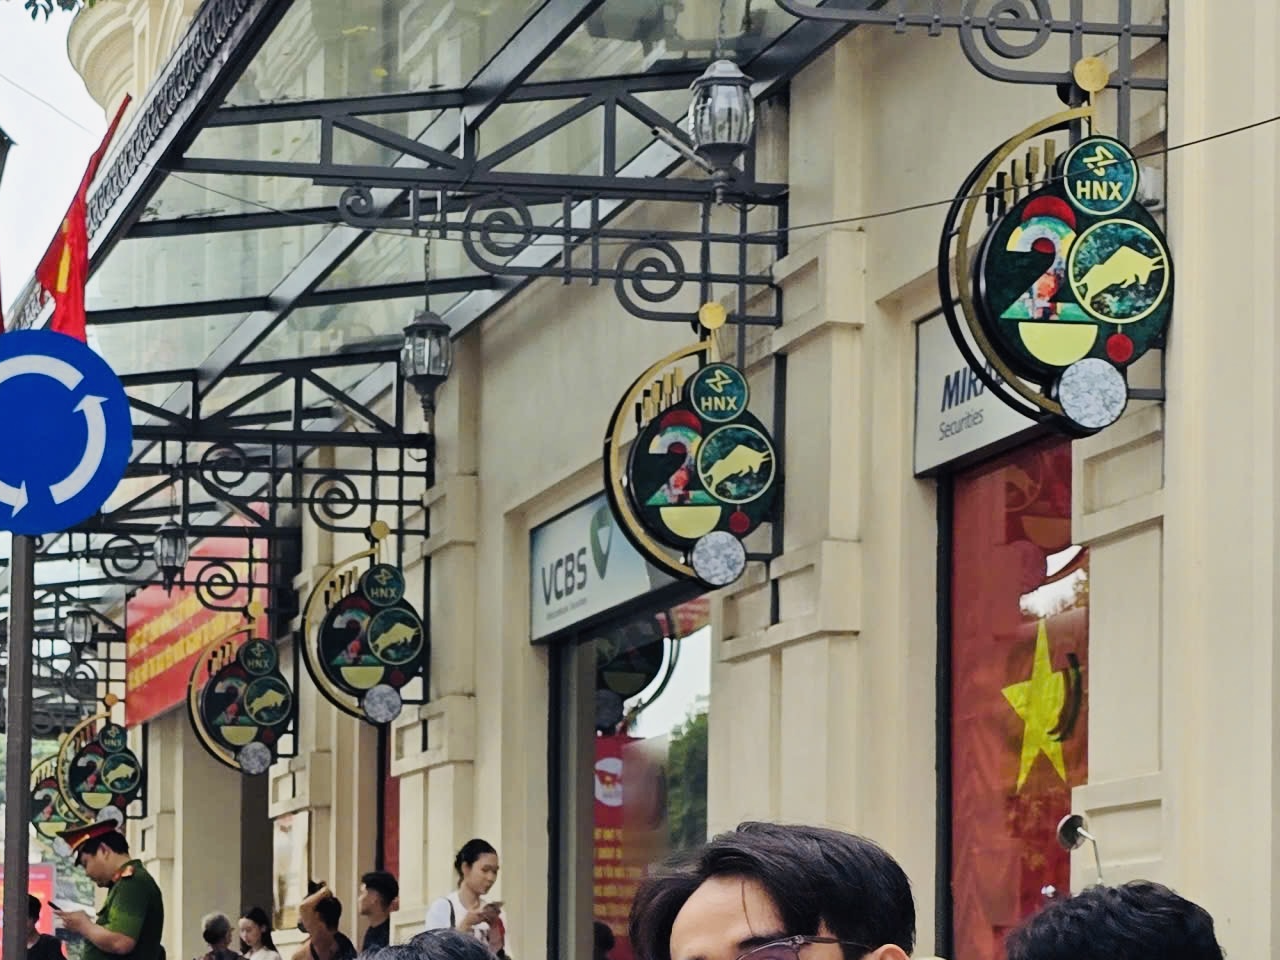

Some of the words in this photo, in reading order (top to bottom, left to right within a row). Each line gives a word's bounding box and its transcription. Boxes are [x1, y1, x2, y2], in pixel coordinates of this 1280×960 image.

[1076, 180, 1124, 201] HNX
[700, 396, 739, 412] HNX
[939, 408, 985, 442] Securities
[541, 547, 588, 606] VCBS
[370, 587, 398, 599] HNX
[246, 659, 270, 670] HNX
